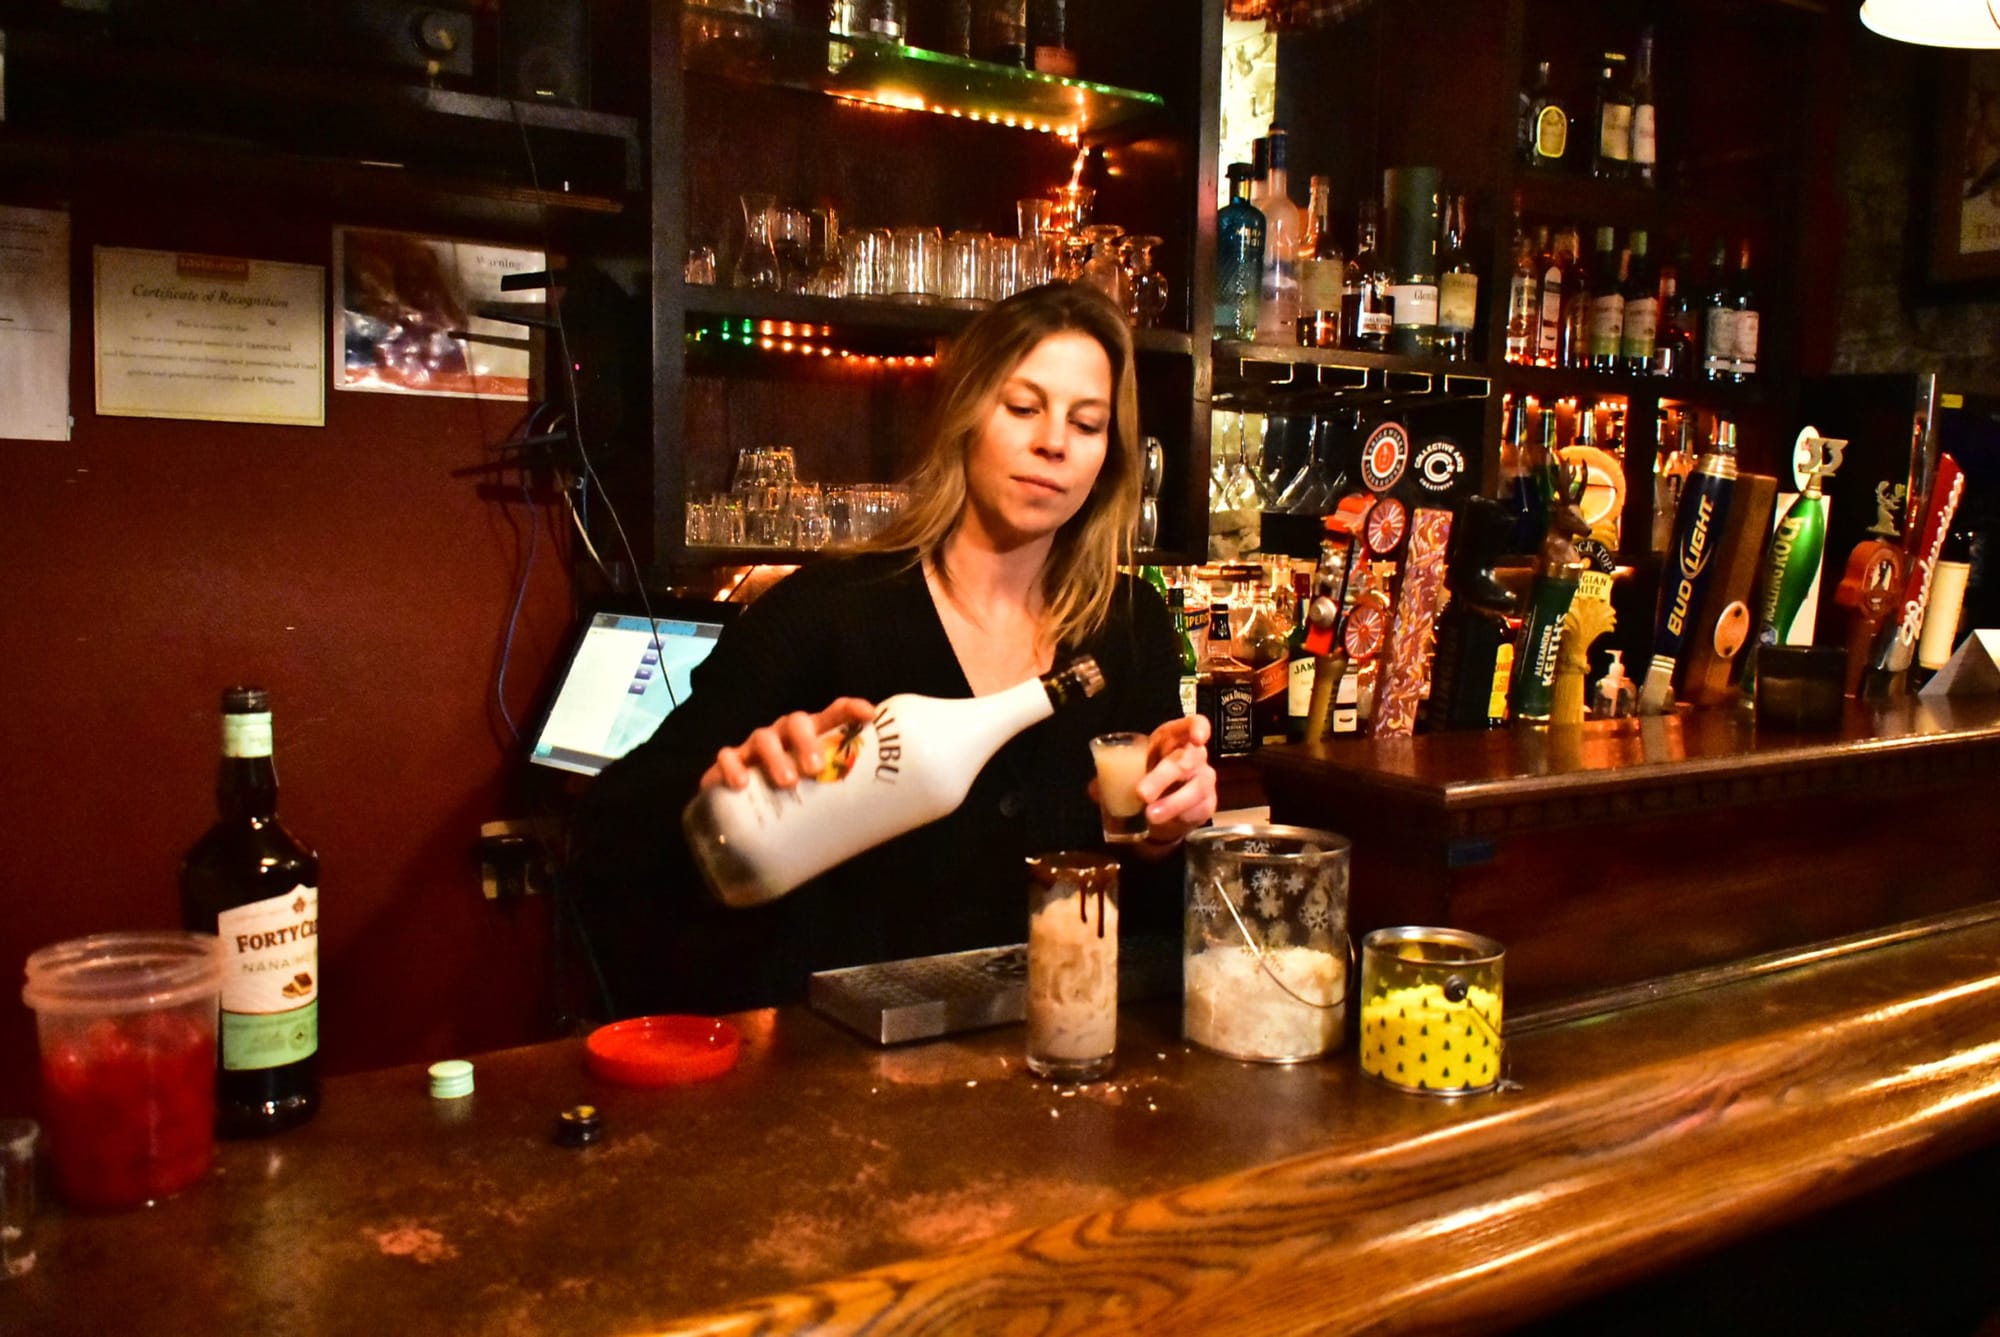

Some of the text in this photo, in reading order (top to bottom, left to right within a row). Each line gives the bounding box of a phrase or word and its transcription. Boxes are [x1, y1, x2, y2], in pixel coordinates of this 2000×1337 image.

[132, 284, 289, 309] Certificate of Recognition
[1414, 442, 1455, 469] COLLECTIVE
[1596, 545, 1613, 570] TOP
[1666, 493, 1715, 637] BUD LIGHT
[1534, 624, 1553, 678] ALEXANDER
[1541, 613, 1569, 687] KEITH'S
[236, 925, 300, 954] FORTY
